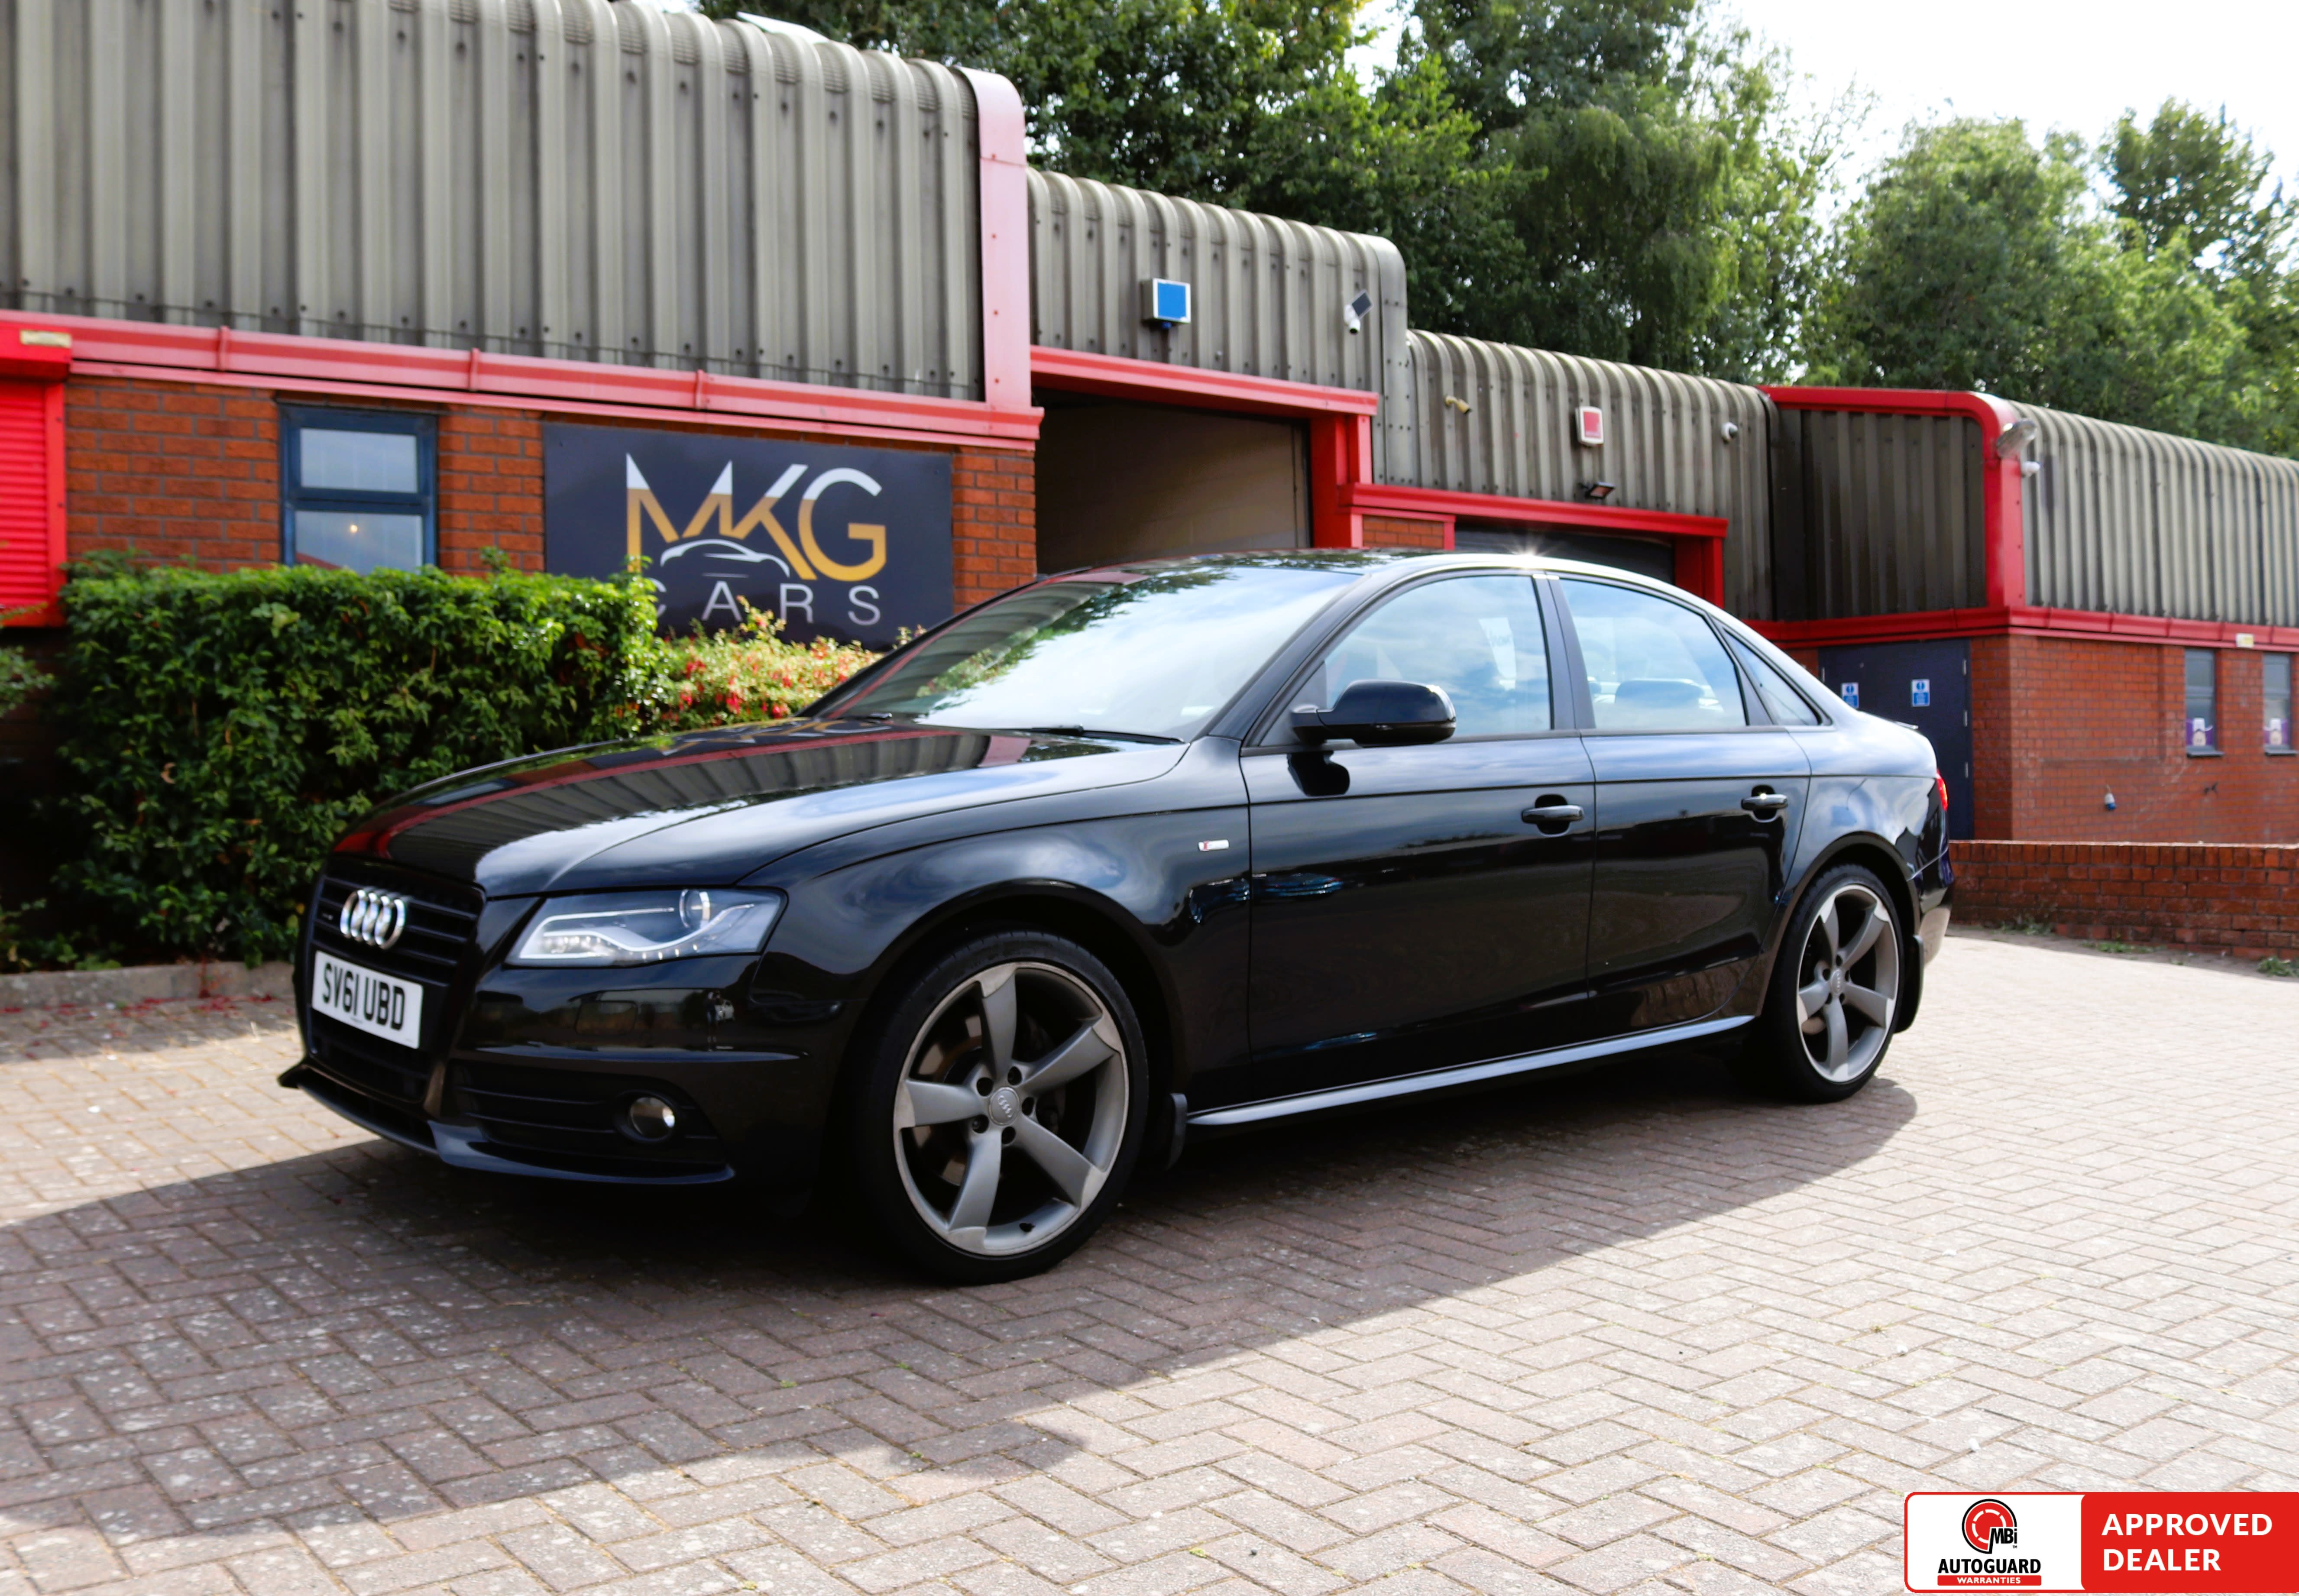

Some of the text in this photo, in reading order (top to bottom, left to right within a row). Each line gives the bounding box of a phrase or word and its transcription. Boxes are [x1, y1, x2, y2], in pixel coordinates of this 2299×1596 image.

[626, 453, 886, 582] MKG
[323, 962, 405, 1031] SV61 UBD
